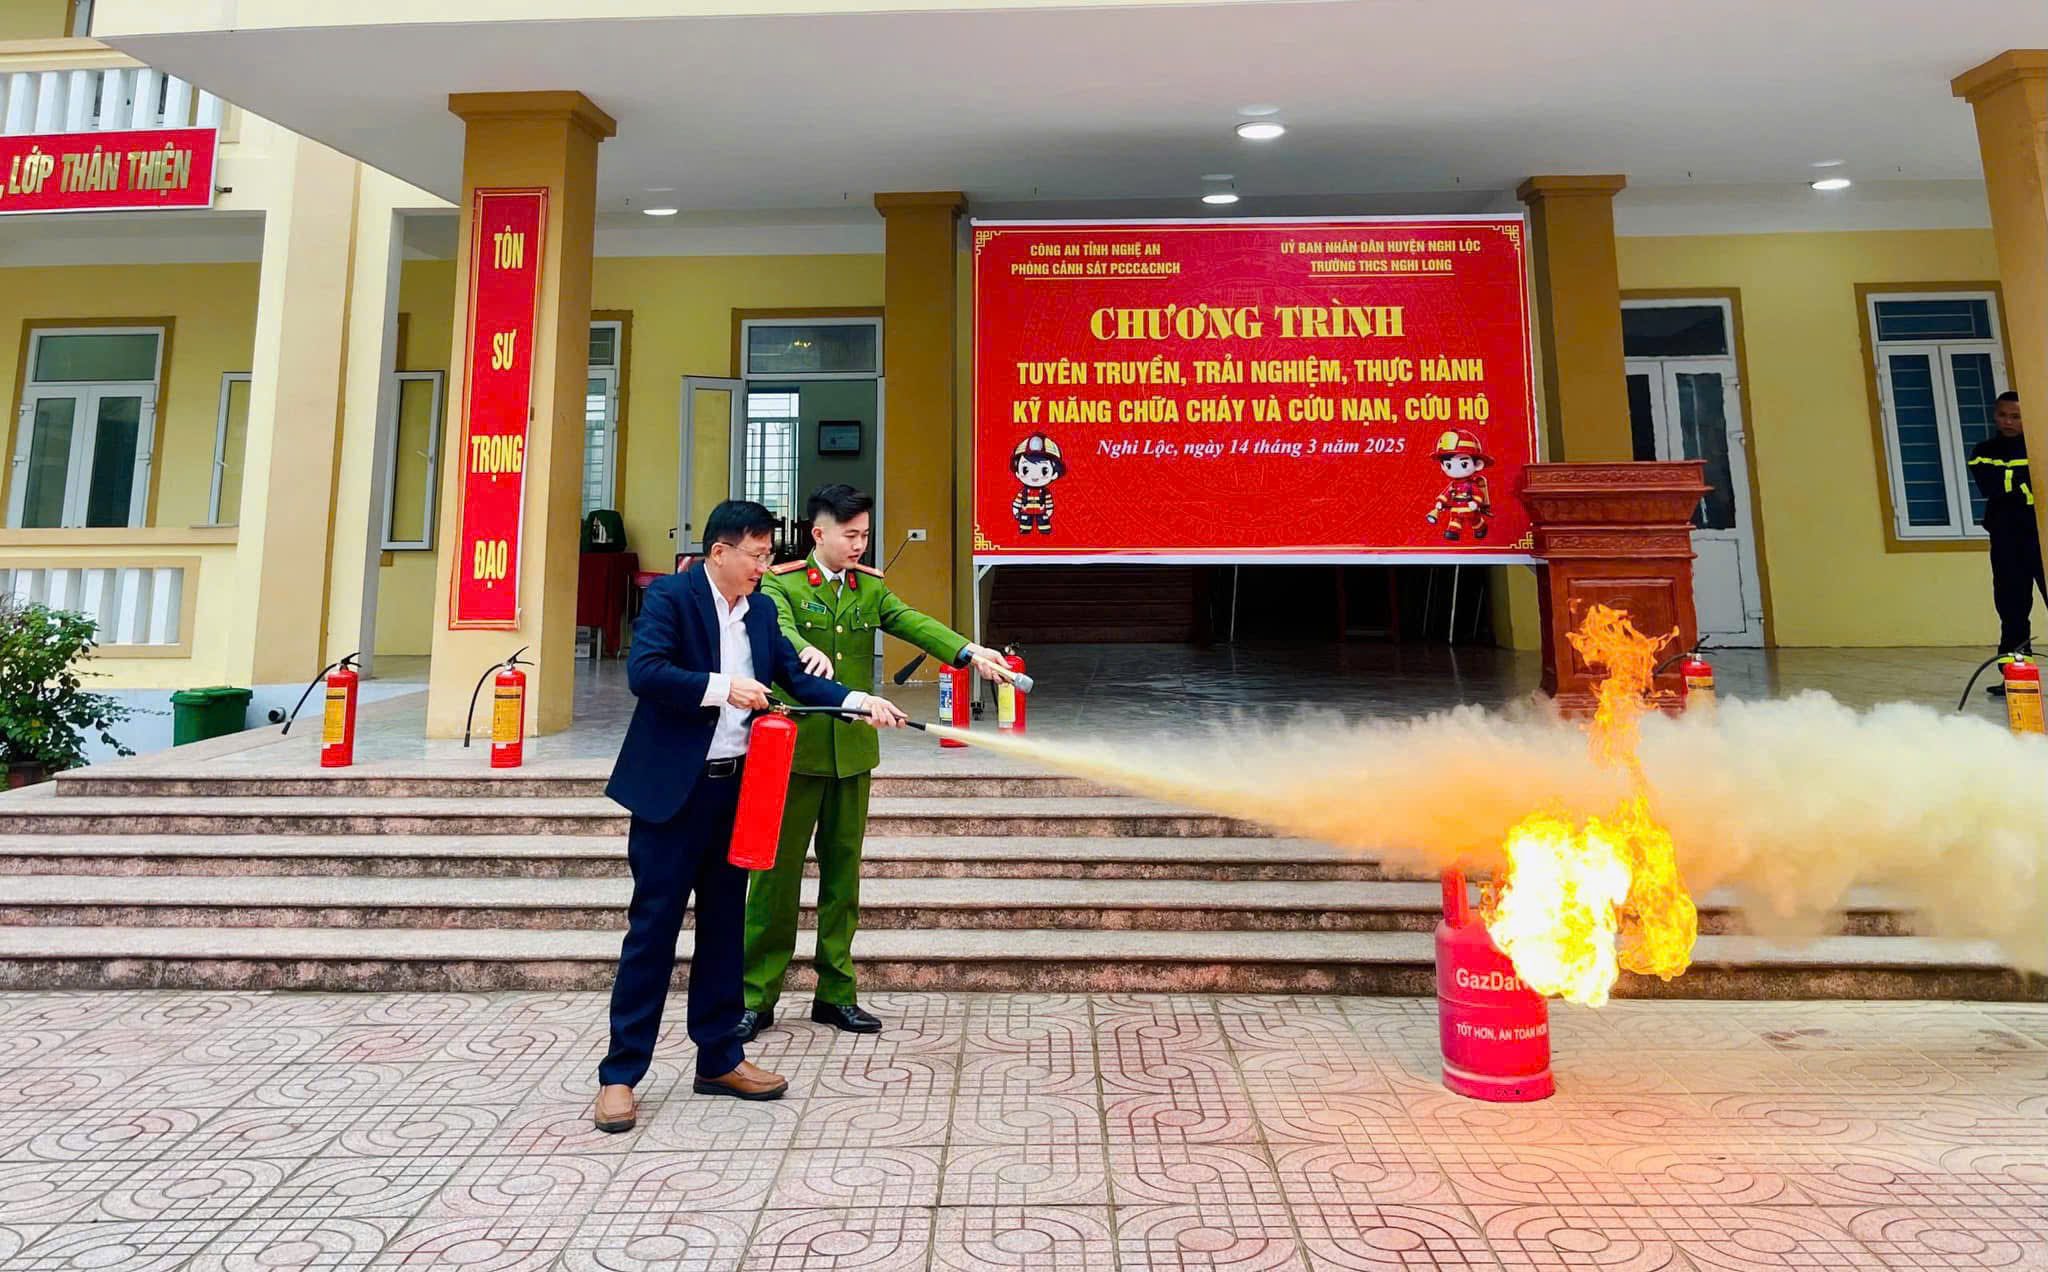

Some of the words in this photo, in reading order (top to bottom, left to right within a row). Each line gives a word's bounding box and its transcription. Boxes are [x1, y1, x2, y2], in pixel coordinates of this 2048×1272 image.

[8, 145, 55, 194] LỚP
[59, 144, 121, 192] THÂN
[127, 141, 192, 196] THIỆN
[493, 225, 524, 270] TÔN
[1030, 242, 1061, 257] CÔNG
[1064, 244, 1080, 257] AN
[1083, 240, 1108, 256] TỈNH
[1111, 241, 1142, 258] NGHỆ
[1144, 243, 1161, 256] AN
[1298, 242, 1322, 254] BAN
[1325, 239, 1357, 254] NHÂN
[1360, 239, 1384, 253] DÂN
[1387, 238, 1425, 256] HUYỆN
[1428, 240, 1456, 252] NGHI
[1459, 237, 1481, 256] LỘC
[1011, 260, 1050, 275] PHÒNG
[1052, 260, 1083, 274] CẢNH
[1086, 260, 1108, 274] SÁT
[1110, 262, 1181, 275] PCCC&CNCH
[1310, 257, 1356, 273] TRƯỜNG
[1359, 260, 1388, 272] THCS
[1391, 259, 1419, 272] NGHI
[1422, 259, 1452, 272] LONG
[1090, 303, 1264, 340] CHƯƠNG
[1274, 298, 1405, 338] TRÌNH
[491, 329, 517, 371] SƯ
[1016, 357, 1087, 385] TUYÊN
[1093, 355, 1187, 387] TRUYỀN,
[1193, 353, 1243, 384] TRẢI
[1250, 355, 1348, 388] NGHIỆM,
[1354, 355, 1413, 387] THỰC
[1420, 354, 1484, 382] HÀNH
[1013, 396, 1042, 423] KỸ
[1048, 396, 1112, 423] NĂNG
[1118, 396, 1180, 423] CHỮA
[1186, 395, 1246, 422] CHÁY
[1251, 395, 1283, 422] VÀ
[1288, 393, 1334, 422] CỨU
[1341, 397, 1399, 426] NẠN,
[1404, 393, 1451, 421] CỨU
[1458, 393, 1490, 425] HỘ
[471, 434, 523, 482] TRỌNG
[1096, 439, 1139, 457] Nghi
[1143, 440, 1179, 456] Lộc,
[1183, 439, 1225, 457] ngày
[1230, 440, 1249, 454] 14
[1253, 437, 1303, 457] tháng
[1307, 439, 1318, 454] 3
[1322, 437, 1360, 454] năm
[1364, 438, 1406, 453] 2025
[473, 540, 507, 589] ĐẠO
